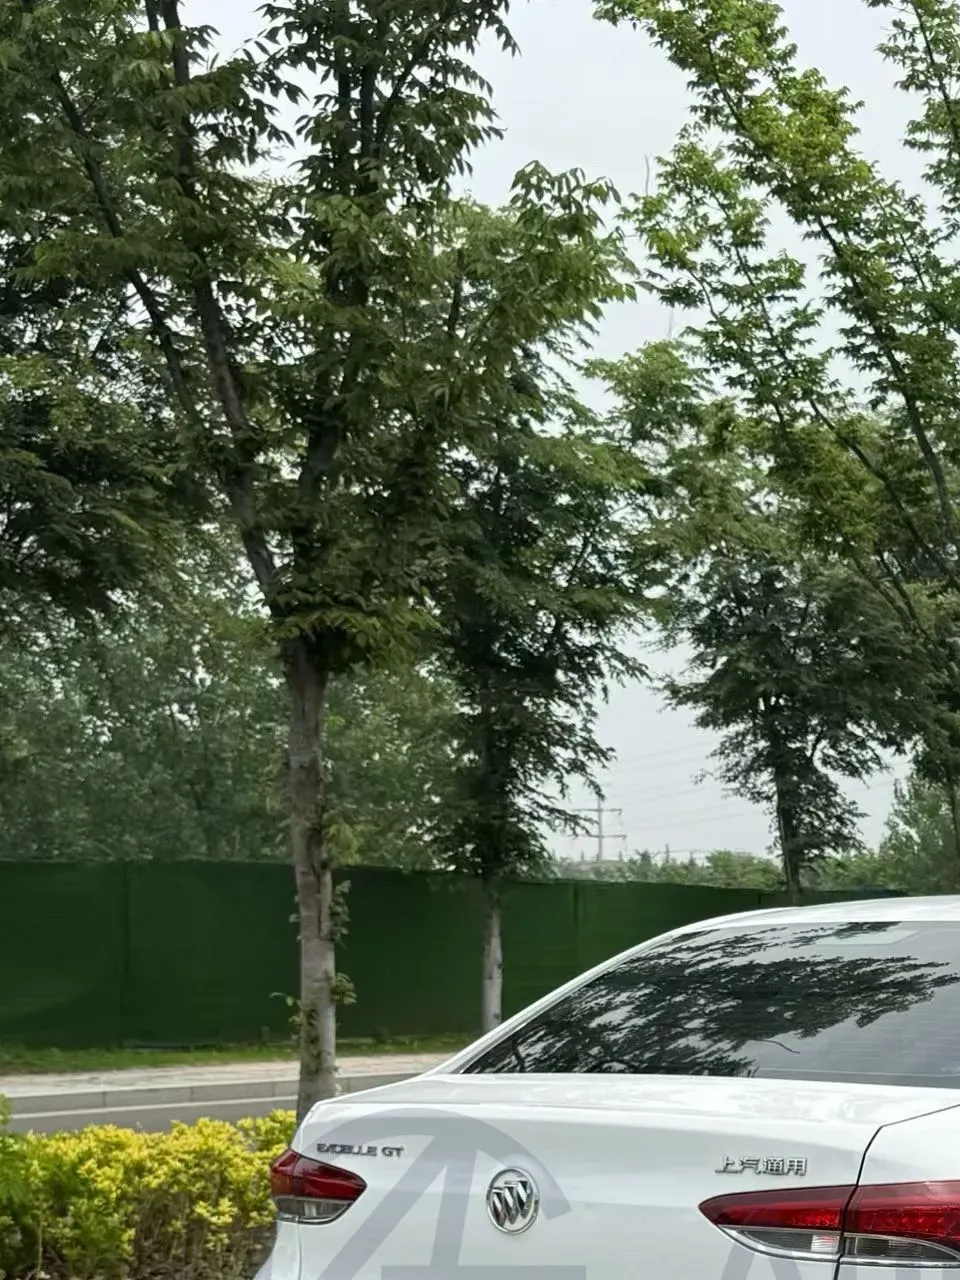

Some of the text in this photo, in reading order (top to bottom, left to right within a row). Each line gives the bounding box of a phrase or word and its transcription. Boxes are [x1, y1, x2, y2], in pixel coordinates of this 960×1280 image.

[381, 1146, 405, 1157] GT
[714, 1155, 808, 1176] 上汽通用
